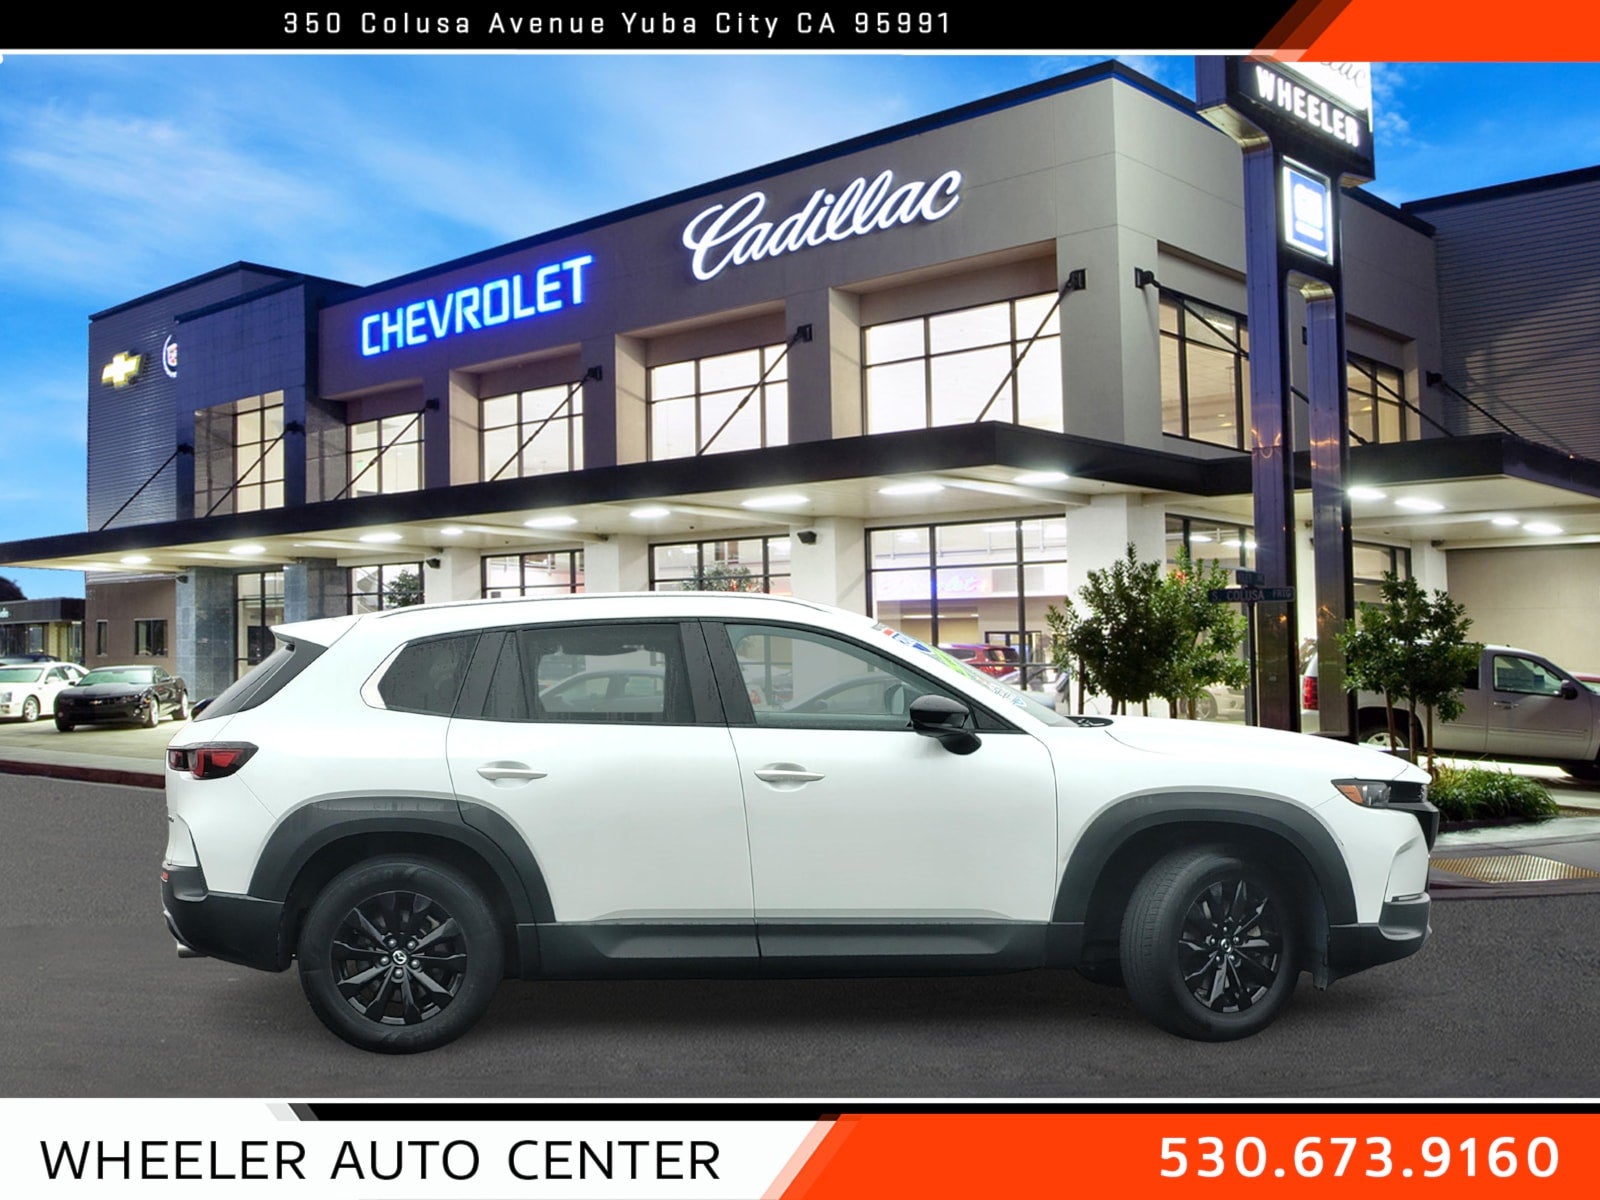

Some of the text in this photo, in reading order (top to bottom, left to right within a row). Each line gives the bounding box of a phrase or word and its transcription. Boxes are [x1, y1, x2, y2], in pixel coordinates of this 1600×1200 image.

[1255, 65, 1360, 148] WHEELER
[682, 168, 963, 281] Cadillac
[360, 254, 595, 357] CHEVROLET
[1226, 589, 1265, 601] COLUSA
